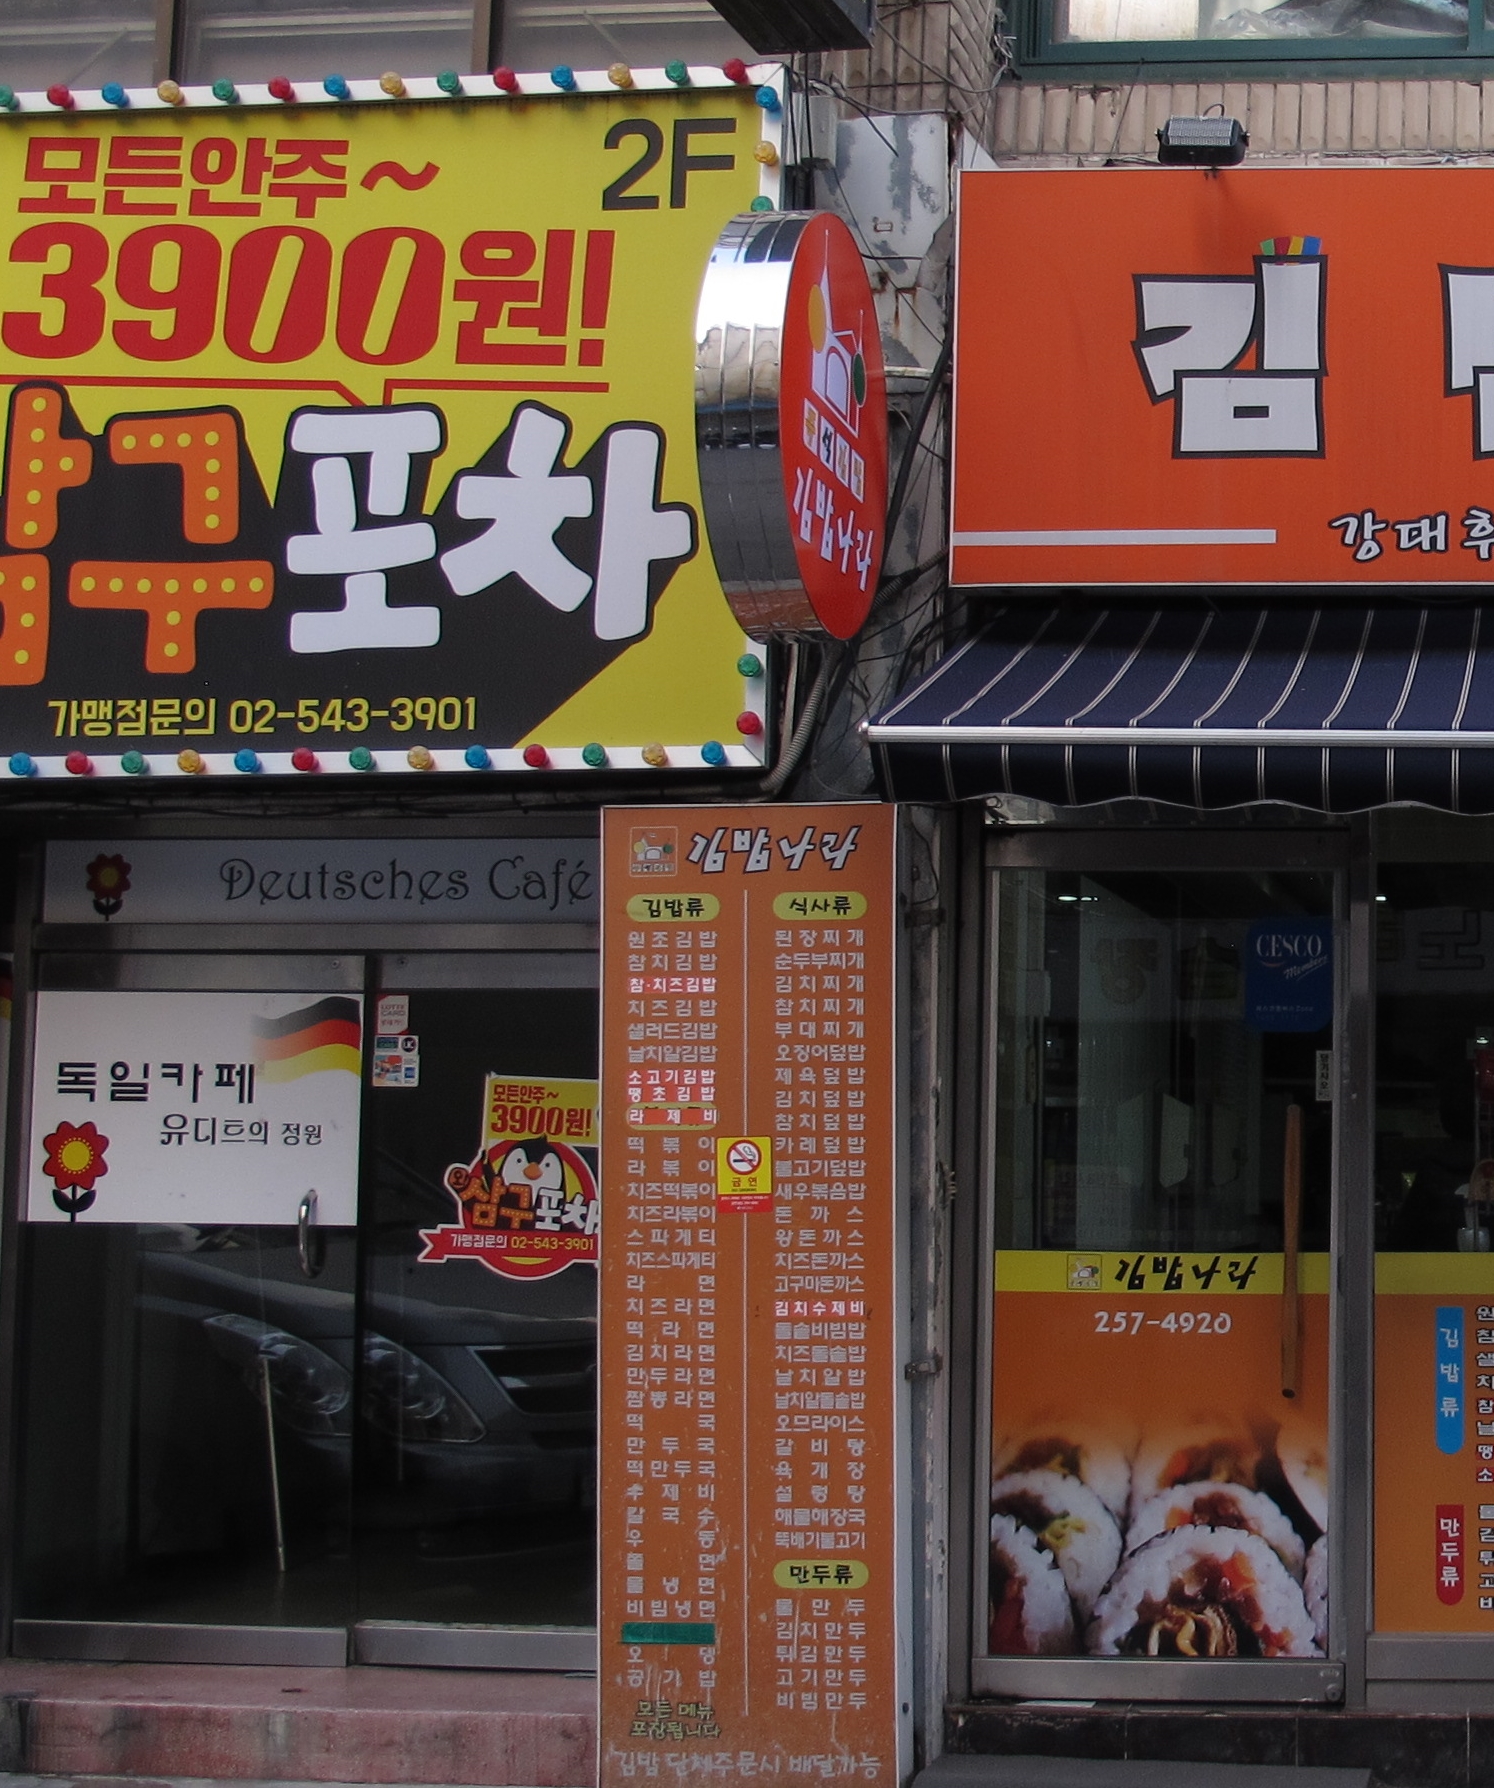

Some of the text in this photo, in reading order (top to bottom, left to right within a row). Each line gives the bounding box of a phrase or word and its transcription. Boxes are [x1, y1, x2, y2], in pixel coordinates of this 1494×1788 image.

[602, 118, 737, 210] 2F
[2, 222, 616, 368] 3900원!
[793, 467, 873, 591] 김밥나라
[48, 697, 478, 738] 가맹점문의 02-543-3901
[686, 825, 863, 875] 김밥나라
[218, 855, 595, 911] Deutsches Café
[642, 895, 852, 919] 김밥류 식사류
[627, 931, 717, 949] 원조김밥
[774, 929, 866, 948] 된장찌개
[1256, 934, 1322, 959] CESCO
[627, 953, 717, 972] 참치김밥
[774, 952, 866, 971] 순두부찌개
[774, 975, 866, 994] 김치찌개
[627, 999, 717, 1017] 치즈김밥
[774, 997, 866, 1017] 참치찌개
[774, 1021, 866, 1040] 부대찌개
[627, 1044, 717, 1064] 날치알김밥
[774, 1044, 866, 1063] 오징어덮밥
[56, 1061, 255, 1104] 독일카페
[627, 1067, 717, 1086] 소고기김밥
[774, 1066, 866, 1086] 제육덮밥
[774, 1090, 866, 1108] 김치덮밥
[160, 1113, 323, 1146] 유디트의 정원
[490, 1104, 593, 1137] 3900원!
[774, 1113, 866, 1132] 참치덮밥
[627, 1136, 716, 1154] 떡볶이
[774, 1136, 866, 1154] 카레덮밥
[627, 1159, 716, 1177] 라볶이
[774, 1159, 866, 1178] 불고기덮밥
[627, 1182, 717, 1200] 치즈떡볶이
[774, 1181, 866, 1201] 새우볶음밥
[627, 1205, 717, 1223] 치즈라볶이
[774, 1205, 866, 1224] 돈까스
[450, 1233, 594, 1250] 가맹점문의 02-543-3901
[627, 1228, 717, 1246] 스파게티
[774, 1229, 866, 1248] 왕돈까스
[627, 1251, 717, 1270] 치즈스파게티
[774, 1252, 866, 1270] 치즈돈까스
[1114, 1254, 1258, 1291] 김밥나라
[774, 1275, 866, 1293] 고구마돈까스
[627, 1297, 717, 1316] 치즈라면
[774, 1300, 866, 1317] 김치수제비
[627, 1321, 716, 1339] 떡라면
[1094, 1310, 1233, 1336] 257-4920
[627, 1344, 717, 1363] 김치라면
[627, 1367, 717, 1386] 만두라면
[774, 1367, 866, 1387] 날치알밥
[1439, 1327, 1460, 1418] 김밥류
[627, 1390, 717, 1410] 짬뽕라면
[774, 1414, 866, 1433] 오므라이스
[627, 1436, 716, 1455] 만두국
[774, 1438, 866, 1457] 갈비탕
[627, 1460, 717, 1479] 떡만두국
[774, 1460, 866, 1481] 육개장
[627, 1483, 716, 1503] 수제비
[774, 1485, 866, 1504] 설렁탕
[627, 1506, 716, 1526] 칼국수
[1440, 1517, 1460, 1588] 만두류
[789, 1564, 853, 1585] 만두류
[627, 1599, 717, 1619] 비빔냉면
[775, 1621, 867, 1641] 김치만두
[775, 1644, 867, 1664] 튀김만두
[627, 1669, 716, 1689] 공기밥
[775, 1668, 867, 1687] 고기만두
[637, 1700, 715, 1720] 모든 메뉴
[775, 1691, 867, 1711] 비빔만두
[631, 1720, 722, 1741] 포장됩니다
[617, 1750, 659, 1778] 김밥
[789, 1752, 882, 1780] 배달가능
